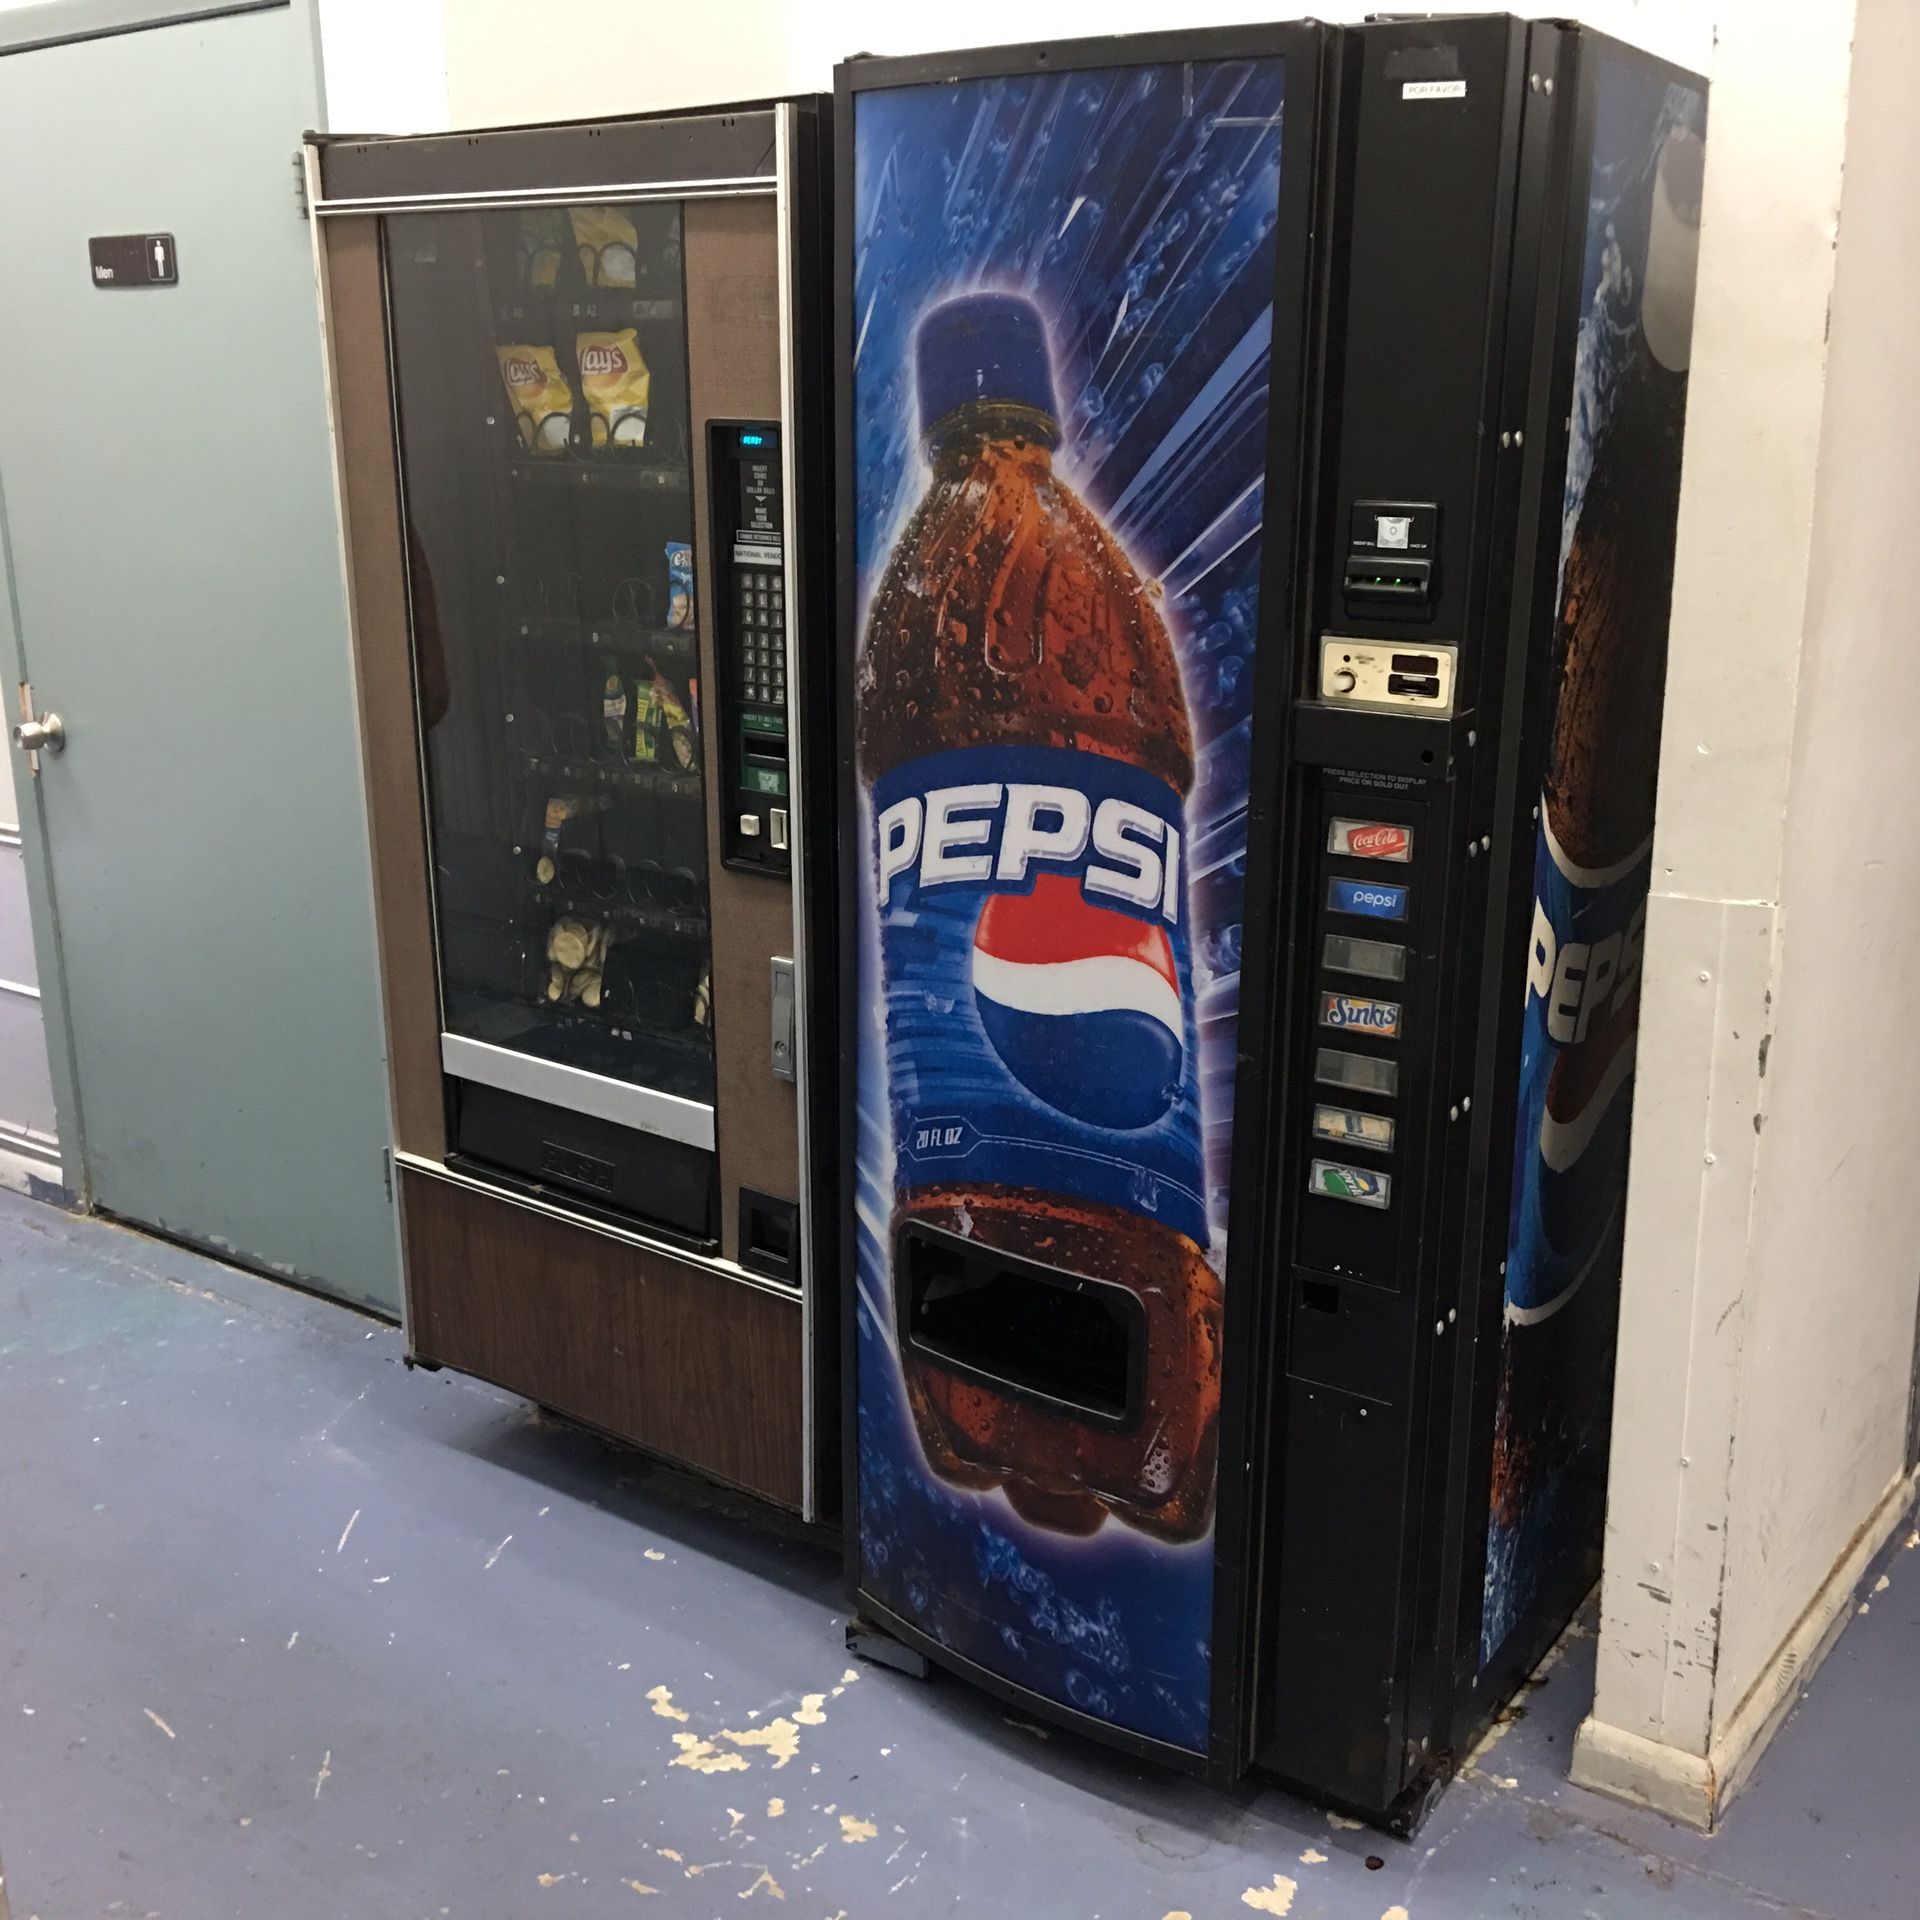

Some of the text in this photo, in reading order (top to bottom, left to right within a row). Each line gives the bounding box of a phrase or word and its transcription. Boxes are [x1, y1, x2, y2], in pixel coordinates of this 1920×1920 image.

[1408, 85, 1427, 94] POR
[1322, 767, 1346, 777] PRESS
[1346, 769, 1386, 781] SELECTION
[1397, 776, 1427, 785] DISPLAY
[1339, 776, 1409, 790] PRICE OR SOLD OUT
[878, 783, 1180, 925] PEPSI
[1353, 890, 1398, 908] pepsi
[916, 1126, 963, 1149] 20 FL OZ
